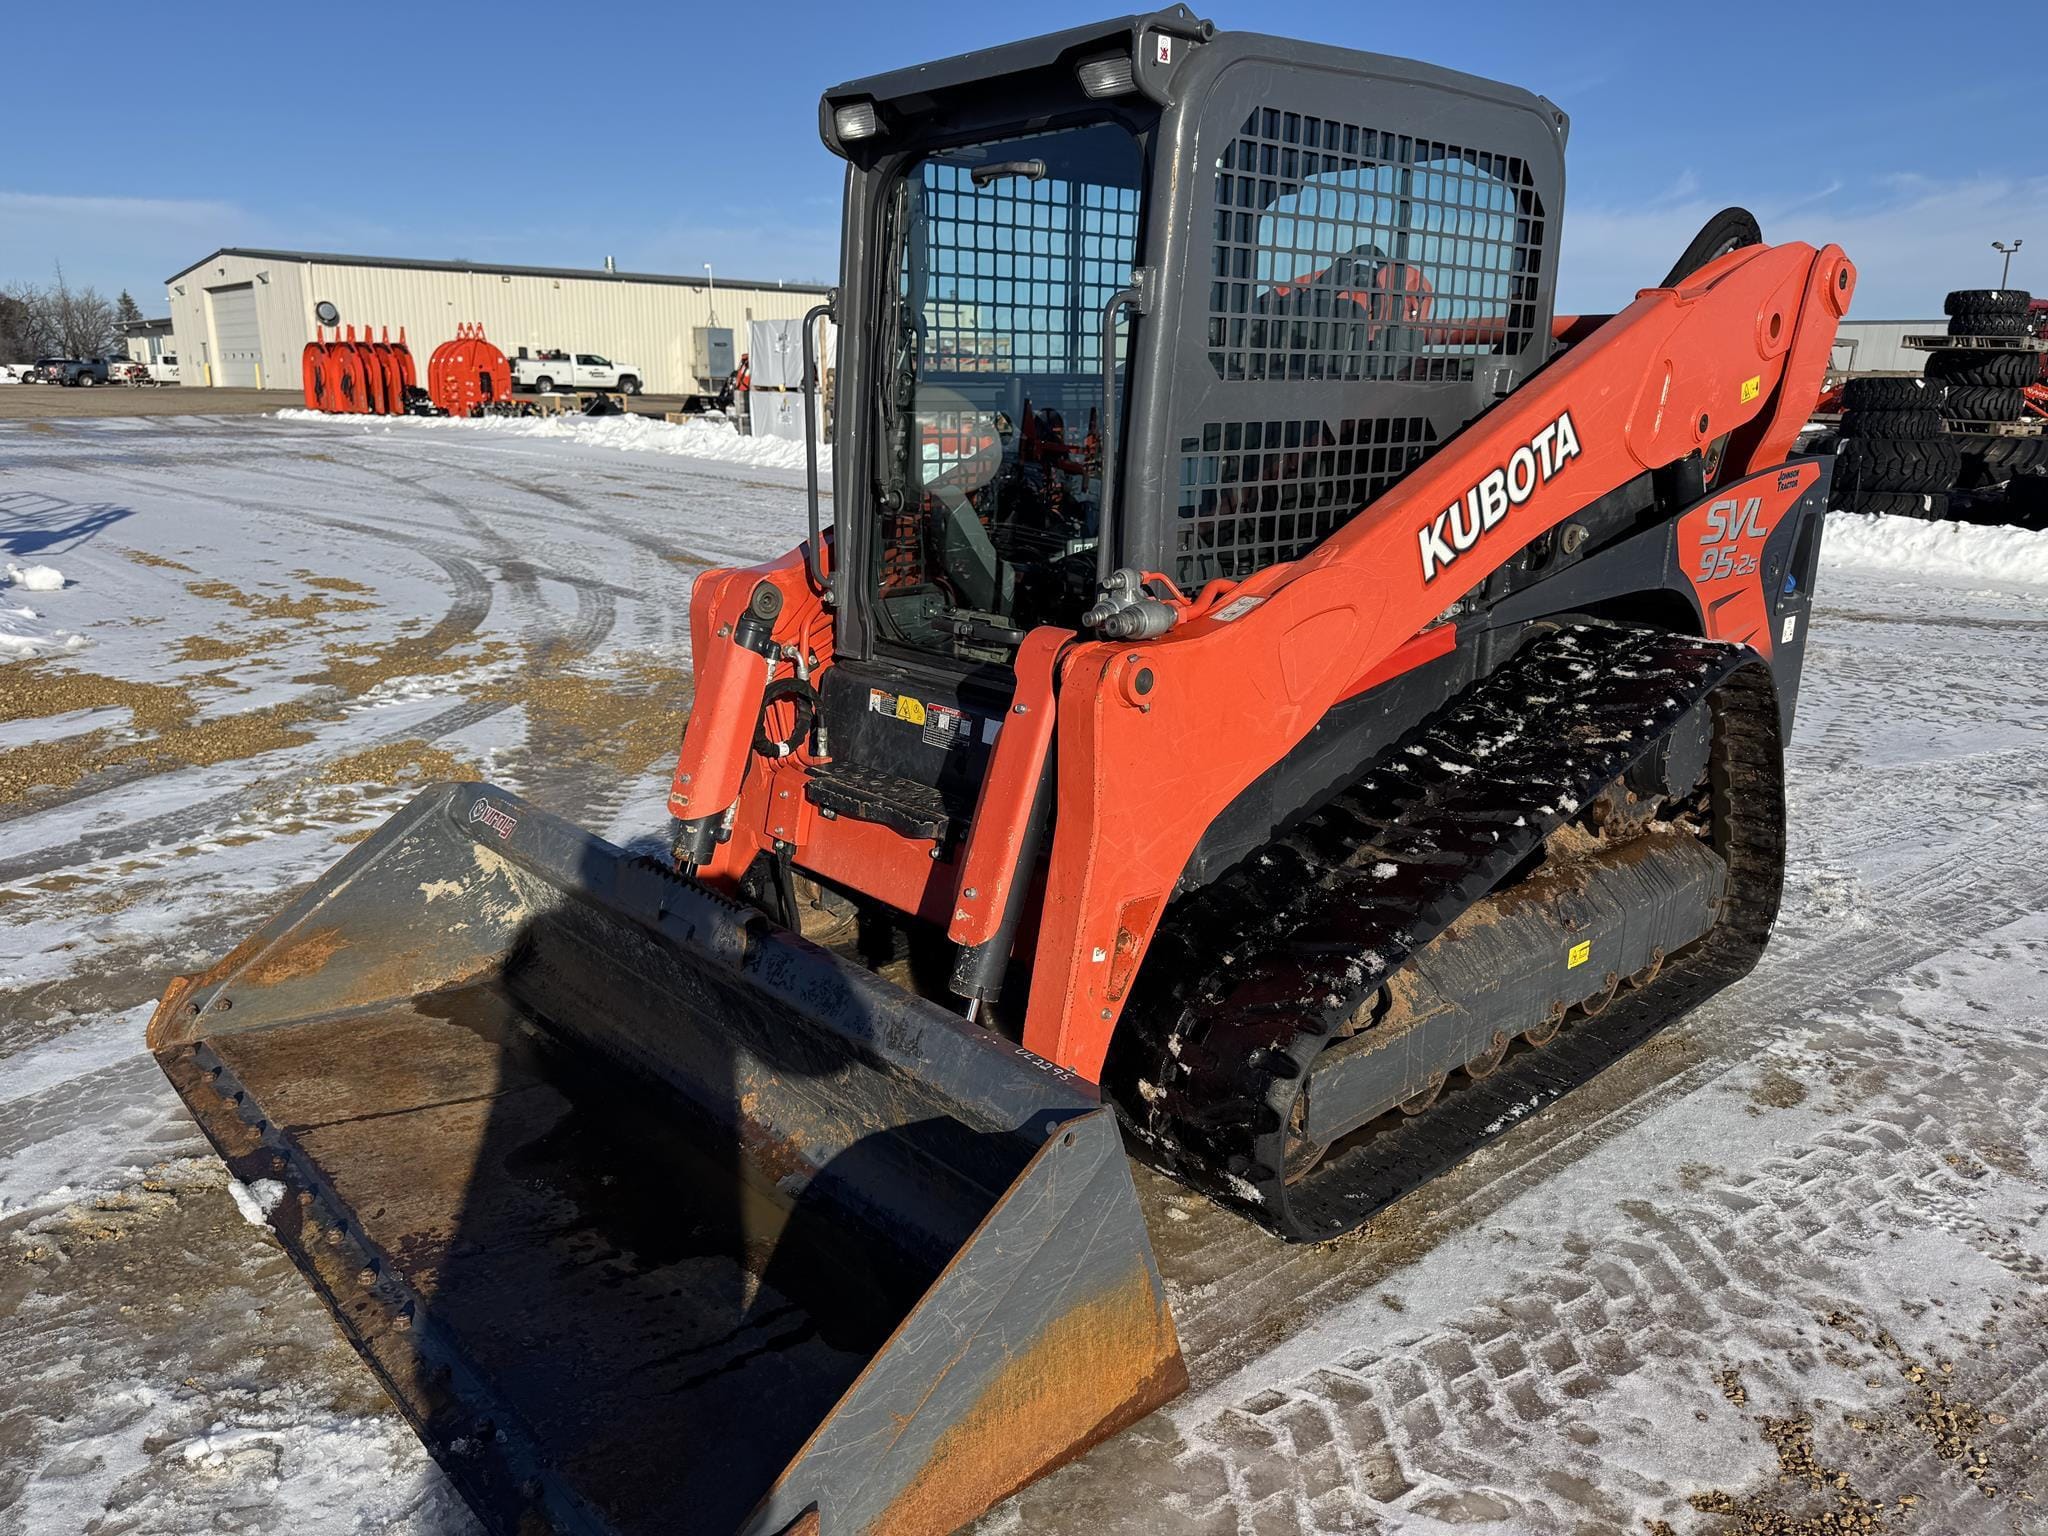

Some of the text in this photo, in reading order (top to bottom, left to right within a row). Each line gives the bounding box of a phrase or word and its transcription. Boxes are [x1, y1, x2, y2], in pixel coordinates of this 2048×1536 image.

[1777, 469, 1800, 482] JOHNSON
[1777, 479, 1798, 492] TRACTOR
[1418, 411, 1582, 583] KUBOTA
[1699, 497, 1767, 545] SVL
